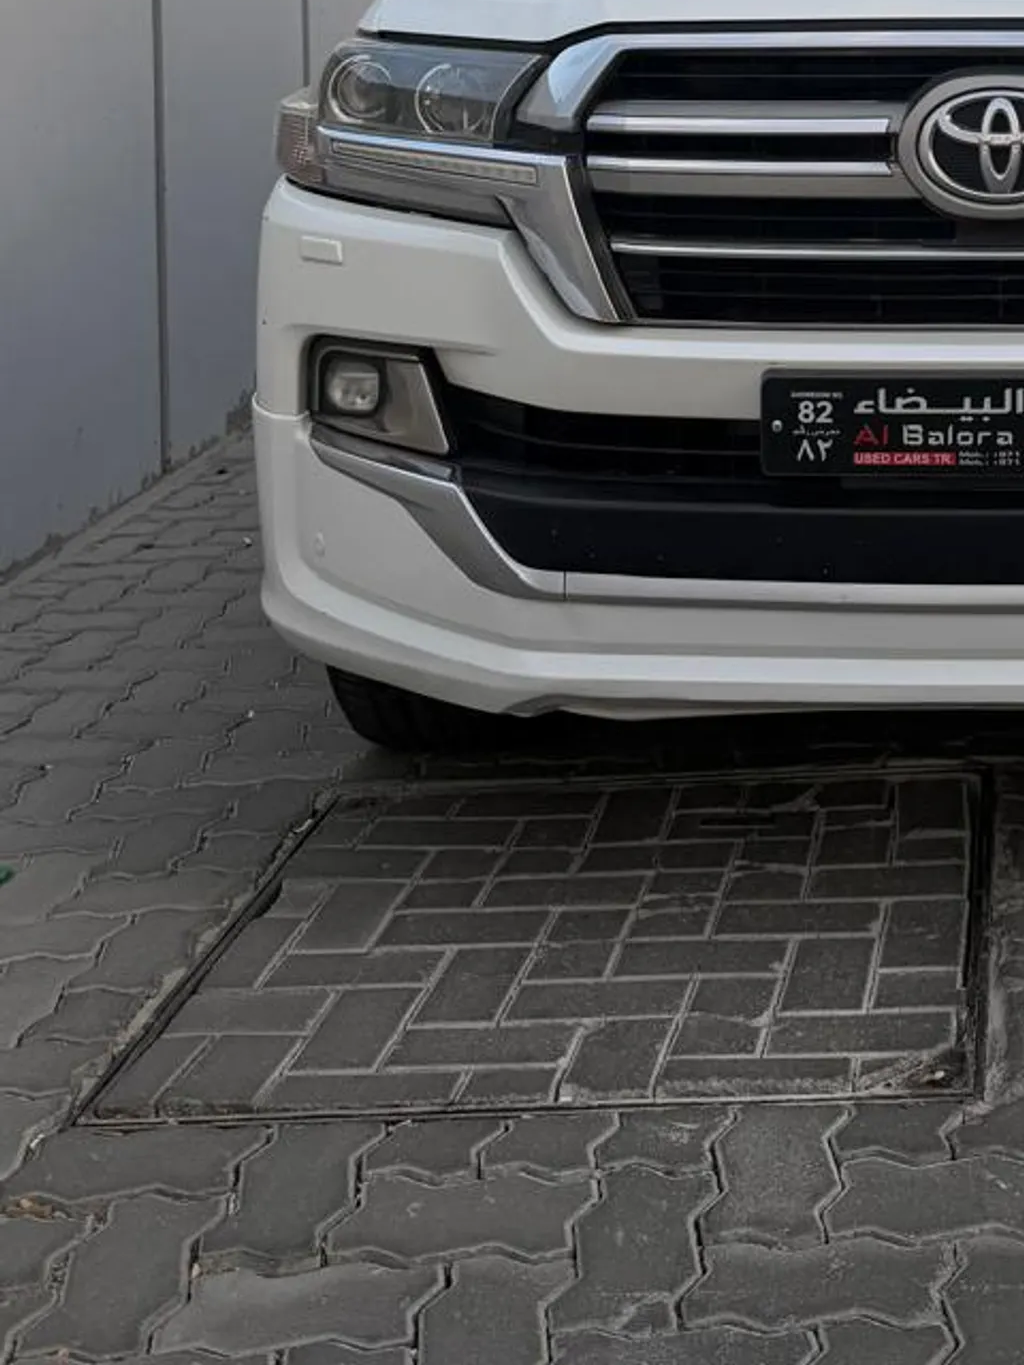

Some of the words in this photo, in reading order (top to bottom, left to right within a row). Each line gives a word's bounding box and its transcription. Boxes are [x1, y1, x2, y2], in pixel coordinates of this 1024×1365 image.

[797, 400, 834, 424] 82
[853, 387, 1024, 422] البيضاء
[853, 423, 889, 446] Al
[902, 423, 1014, 446] Balora
[796, 438, 834, 462] ٨٢
[853, 452, 891, 465] USED
[893, 452, 931, 465] CARS
